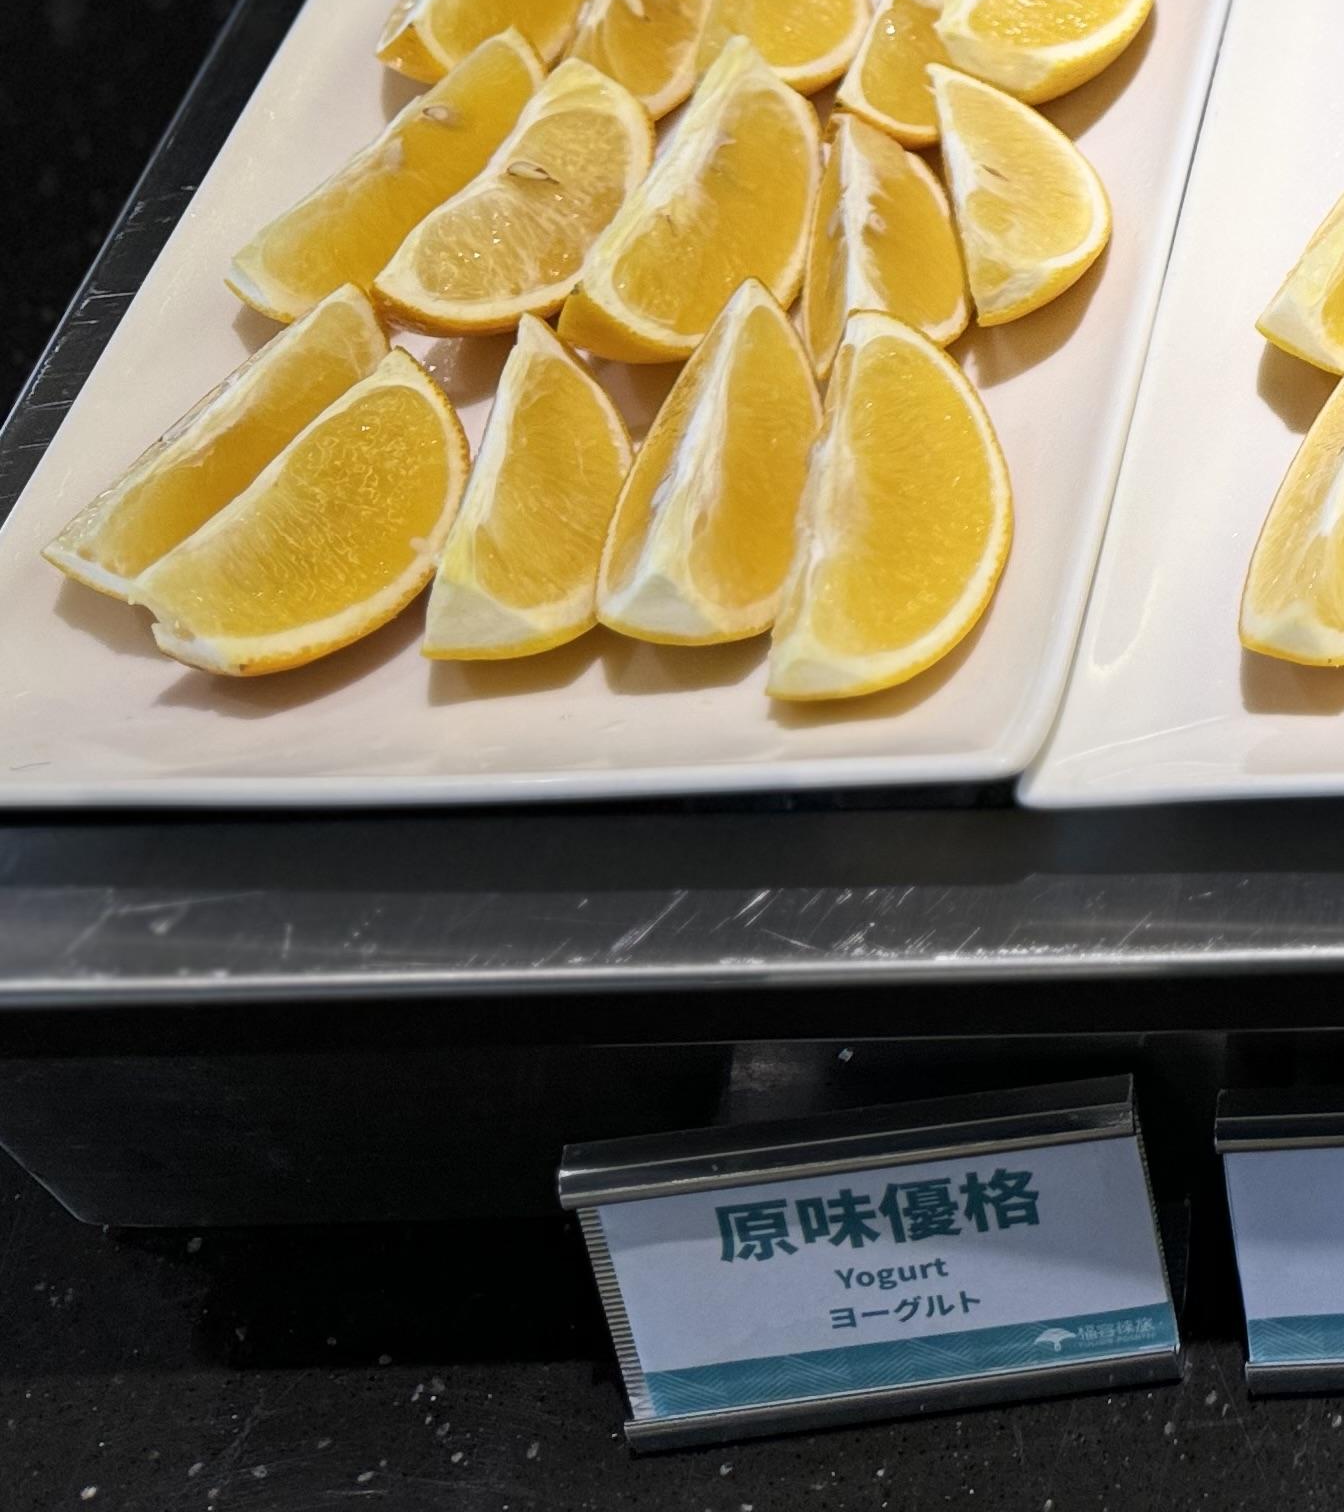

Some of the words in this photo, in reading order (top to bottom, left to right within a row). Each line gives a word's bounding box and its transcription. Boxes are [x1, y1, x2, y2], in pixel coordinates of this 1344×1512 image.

[714, 1167, 1042, 1263] 原味優格
[834, 1257, 950, 1291] Yogurt
[829, 1290, 982, 1331] ヨーグルト
